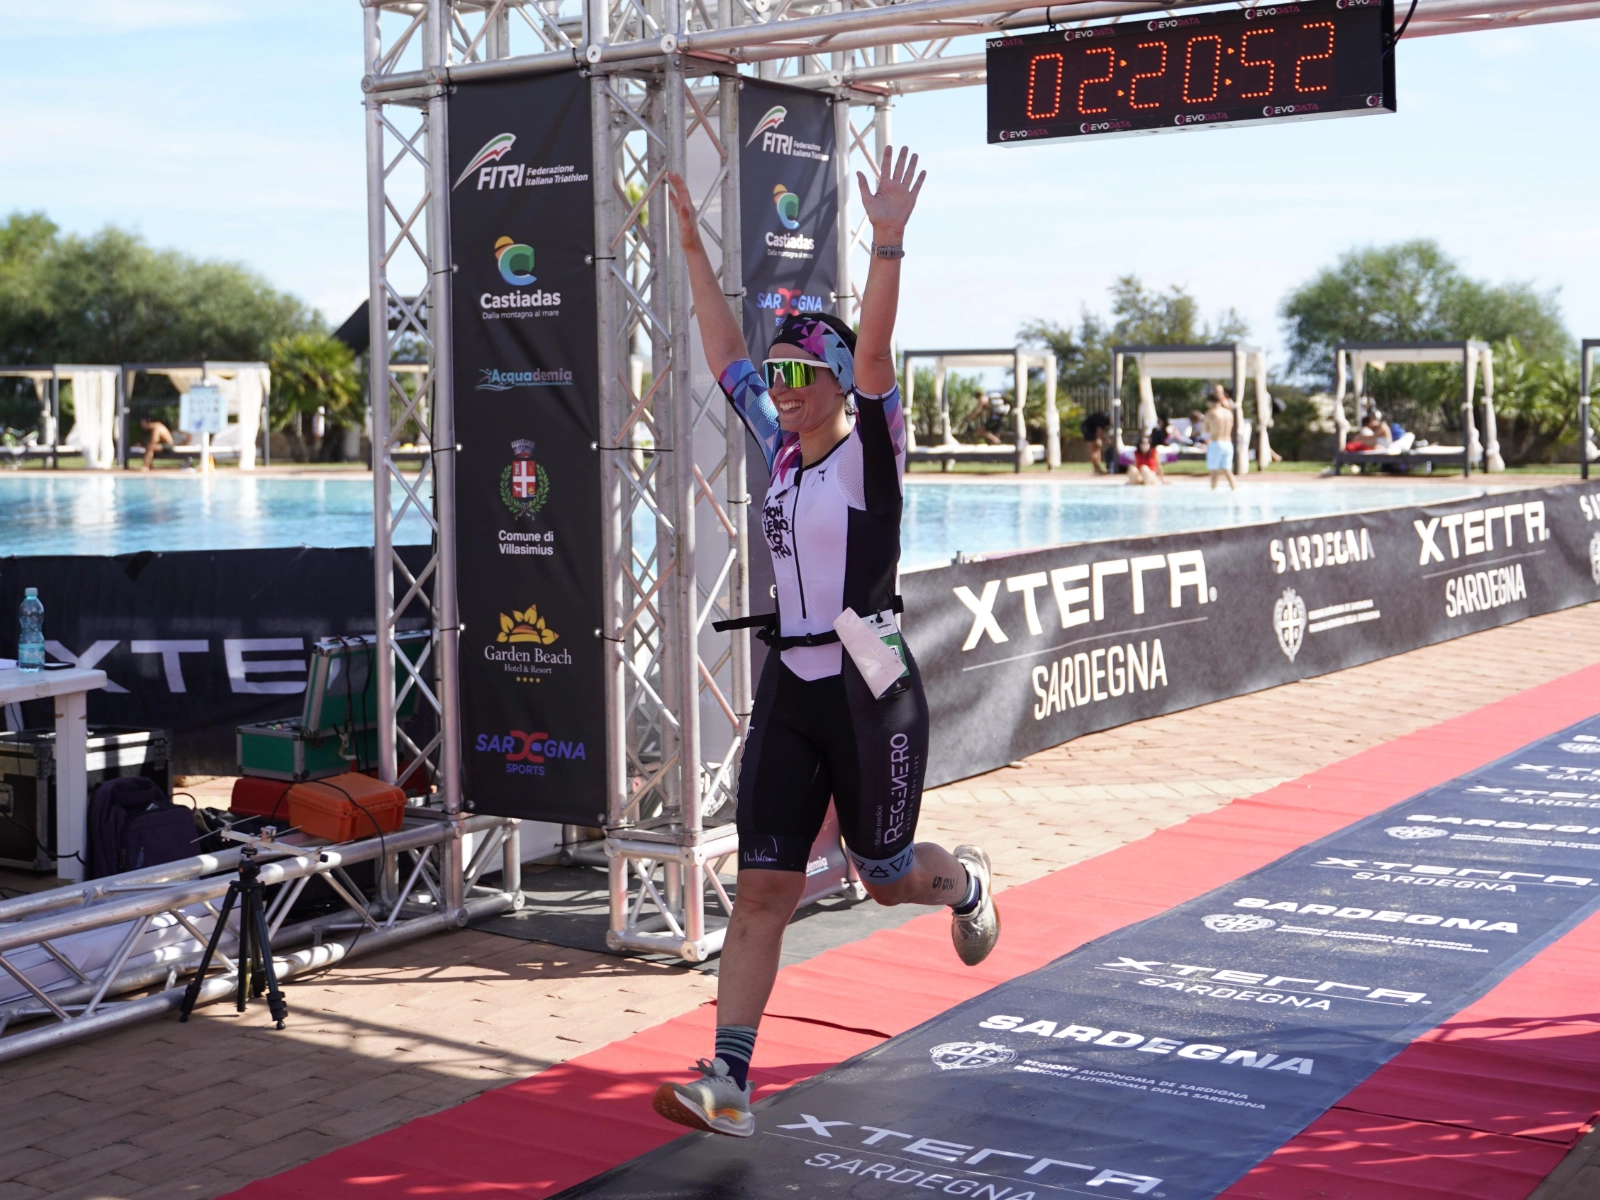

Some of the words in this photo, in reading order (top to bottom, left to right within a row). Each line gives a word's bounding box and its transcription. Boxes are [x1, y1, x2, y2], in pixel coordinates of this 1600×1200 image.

[1256, 6, 1300, 17] EVODATA
[1158, 17, 1200, 29] EVODATA
[1074, 27, 1115, 39] EVODATA
[1027, 21, 1335, 119] 02:20:52
[1185, 111, 1228, 123] EVODATA
[1275, 103, 1319, 115] EVODATA
[1009, 128, 1048, 139] EVODATA
[1090, 120, 1131, 131] EVODATA
[762, 131, 793, 156] FITRI
[477, 163, 525, 190] FITRI
[525, 176, 553, 186] Italiana
[554, 172, 588, 184] Triathlon
[526, 164, 575, 176] Federazione
[765, 231, 815, 250] Castiadas
[480, 289, 561, 309] Castiadas
[482, 311, 500, 320] Dalla
[501, 311, 533, 320] montagna
[534, 309, 541, 318] al
[542, 309, 560, 317] mare
[491, 367, 573, 385] Acquademia
[498, 530, 541, 542] Comune
[543, 531, 554, 542] di
[498, 543, 554, 555] Villasimius
[1270, 527, 1375, 574] SARDEGNA
[1445, 563, 1527, 618] SARDEGNA
[484, 645, 531, 663] Garden
[534, 647, 572, 665] Beach
[504, 663, 522, 673] Hotel
[523, 665, 530, 673] &
[530, 665, 552, 674] Resort
[1032, 638, 1168, 720] SARDEGNA
[506, 763, 545, 776] SPORTS
[1352, 871, 1517, 892] SARDEGNA
[1233, 897, 1518, 934] SARDEGNA
[1138, 978, 1331, 1011] SARDEGNA
[978, 1014, 1315, 1076] SARDEGNA
[1014, 1065, 1071, 1079] REGIONE
[1072, 1074, 1148, 1091] AUTONOMA
[1150, 1086, 1189, 1097] DELLA
[1191, 1093, 1266, 1110] SARDEGNA
[1023, 1059, 1079, 1073] REGIONE
[1158, 1080, 1177, 1088] DE
[1178, 1083, 1249, 1099] SARDIGNA
[804, 1152, 1037, 1200] SARDEGNA
